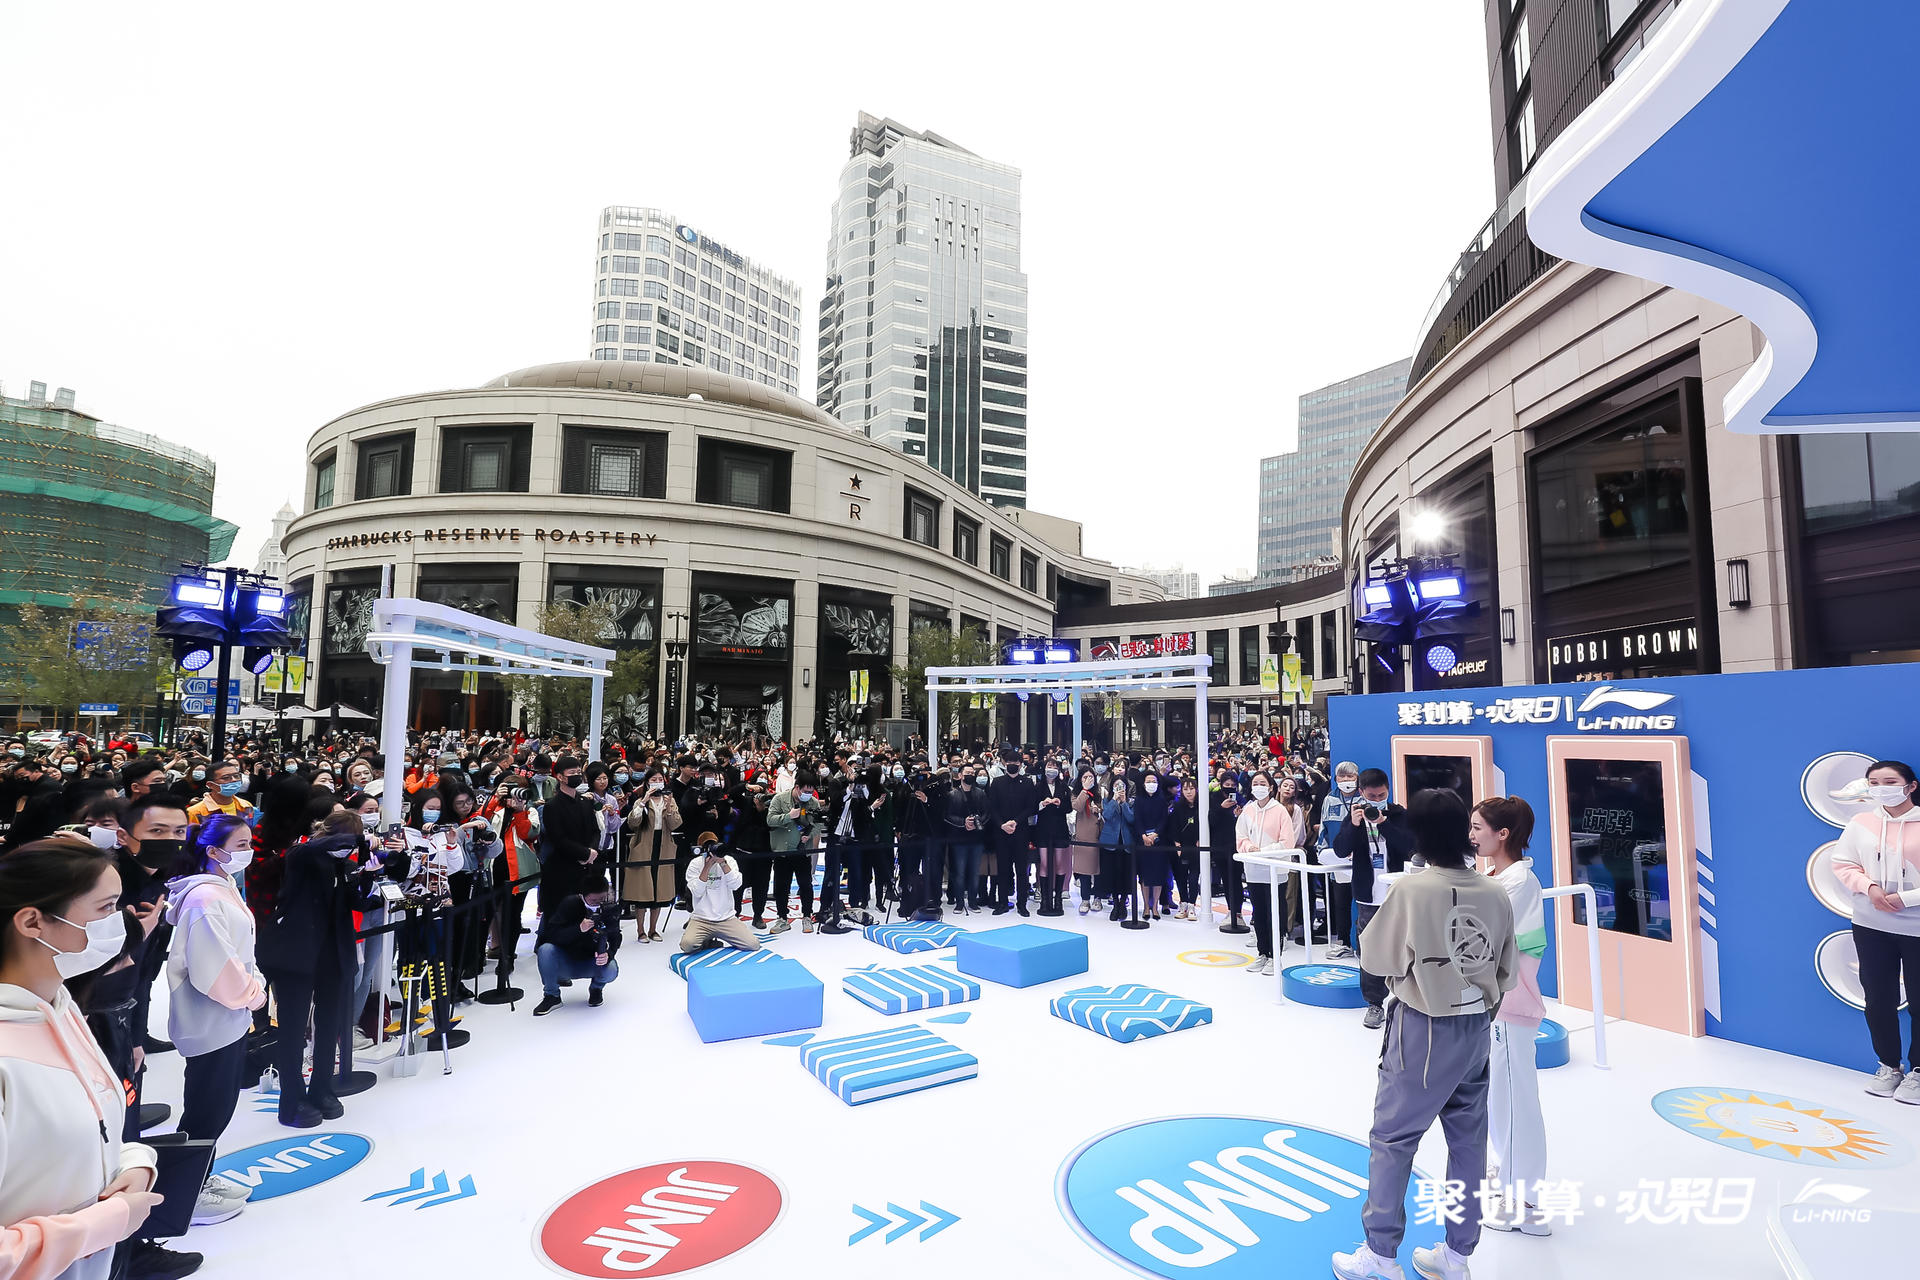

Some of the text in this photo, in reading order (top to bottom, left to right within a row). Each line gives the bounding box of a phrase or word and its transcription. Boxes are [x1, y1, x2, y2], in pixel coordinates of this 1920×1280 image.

[850, 503, 861, 521] R
[327, 528, 657, 550] STARBUCKS RESERVE ROASTERY
[1552, 627, 1698, 665] BOBBI BROWN
[1577, 714, 1678, 731] LI-NING
[221, 1135, 346, 1187] JUM
[1115, 1129, 1369, 1268] JUMP
[581, 1166, 741, 1272] JUMP
